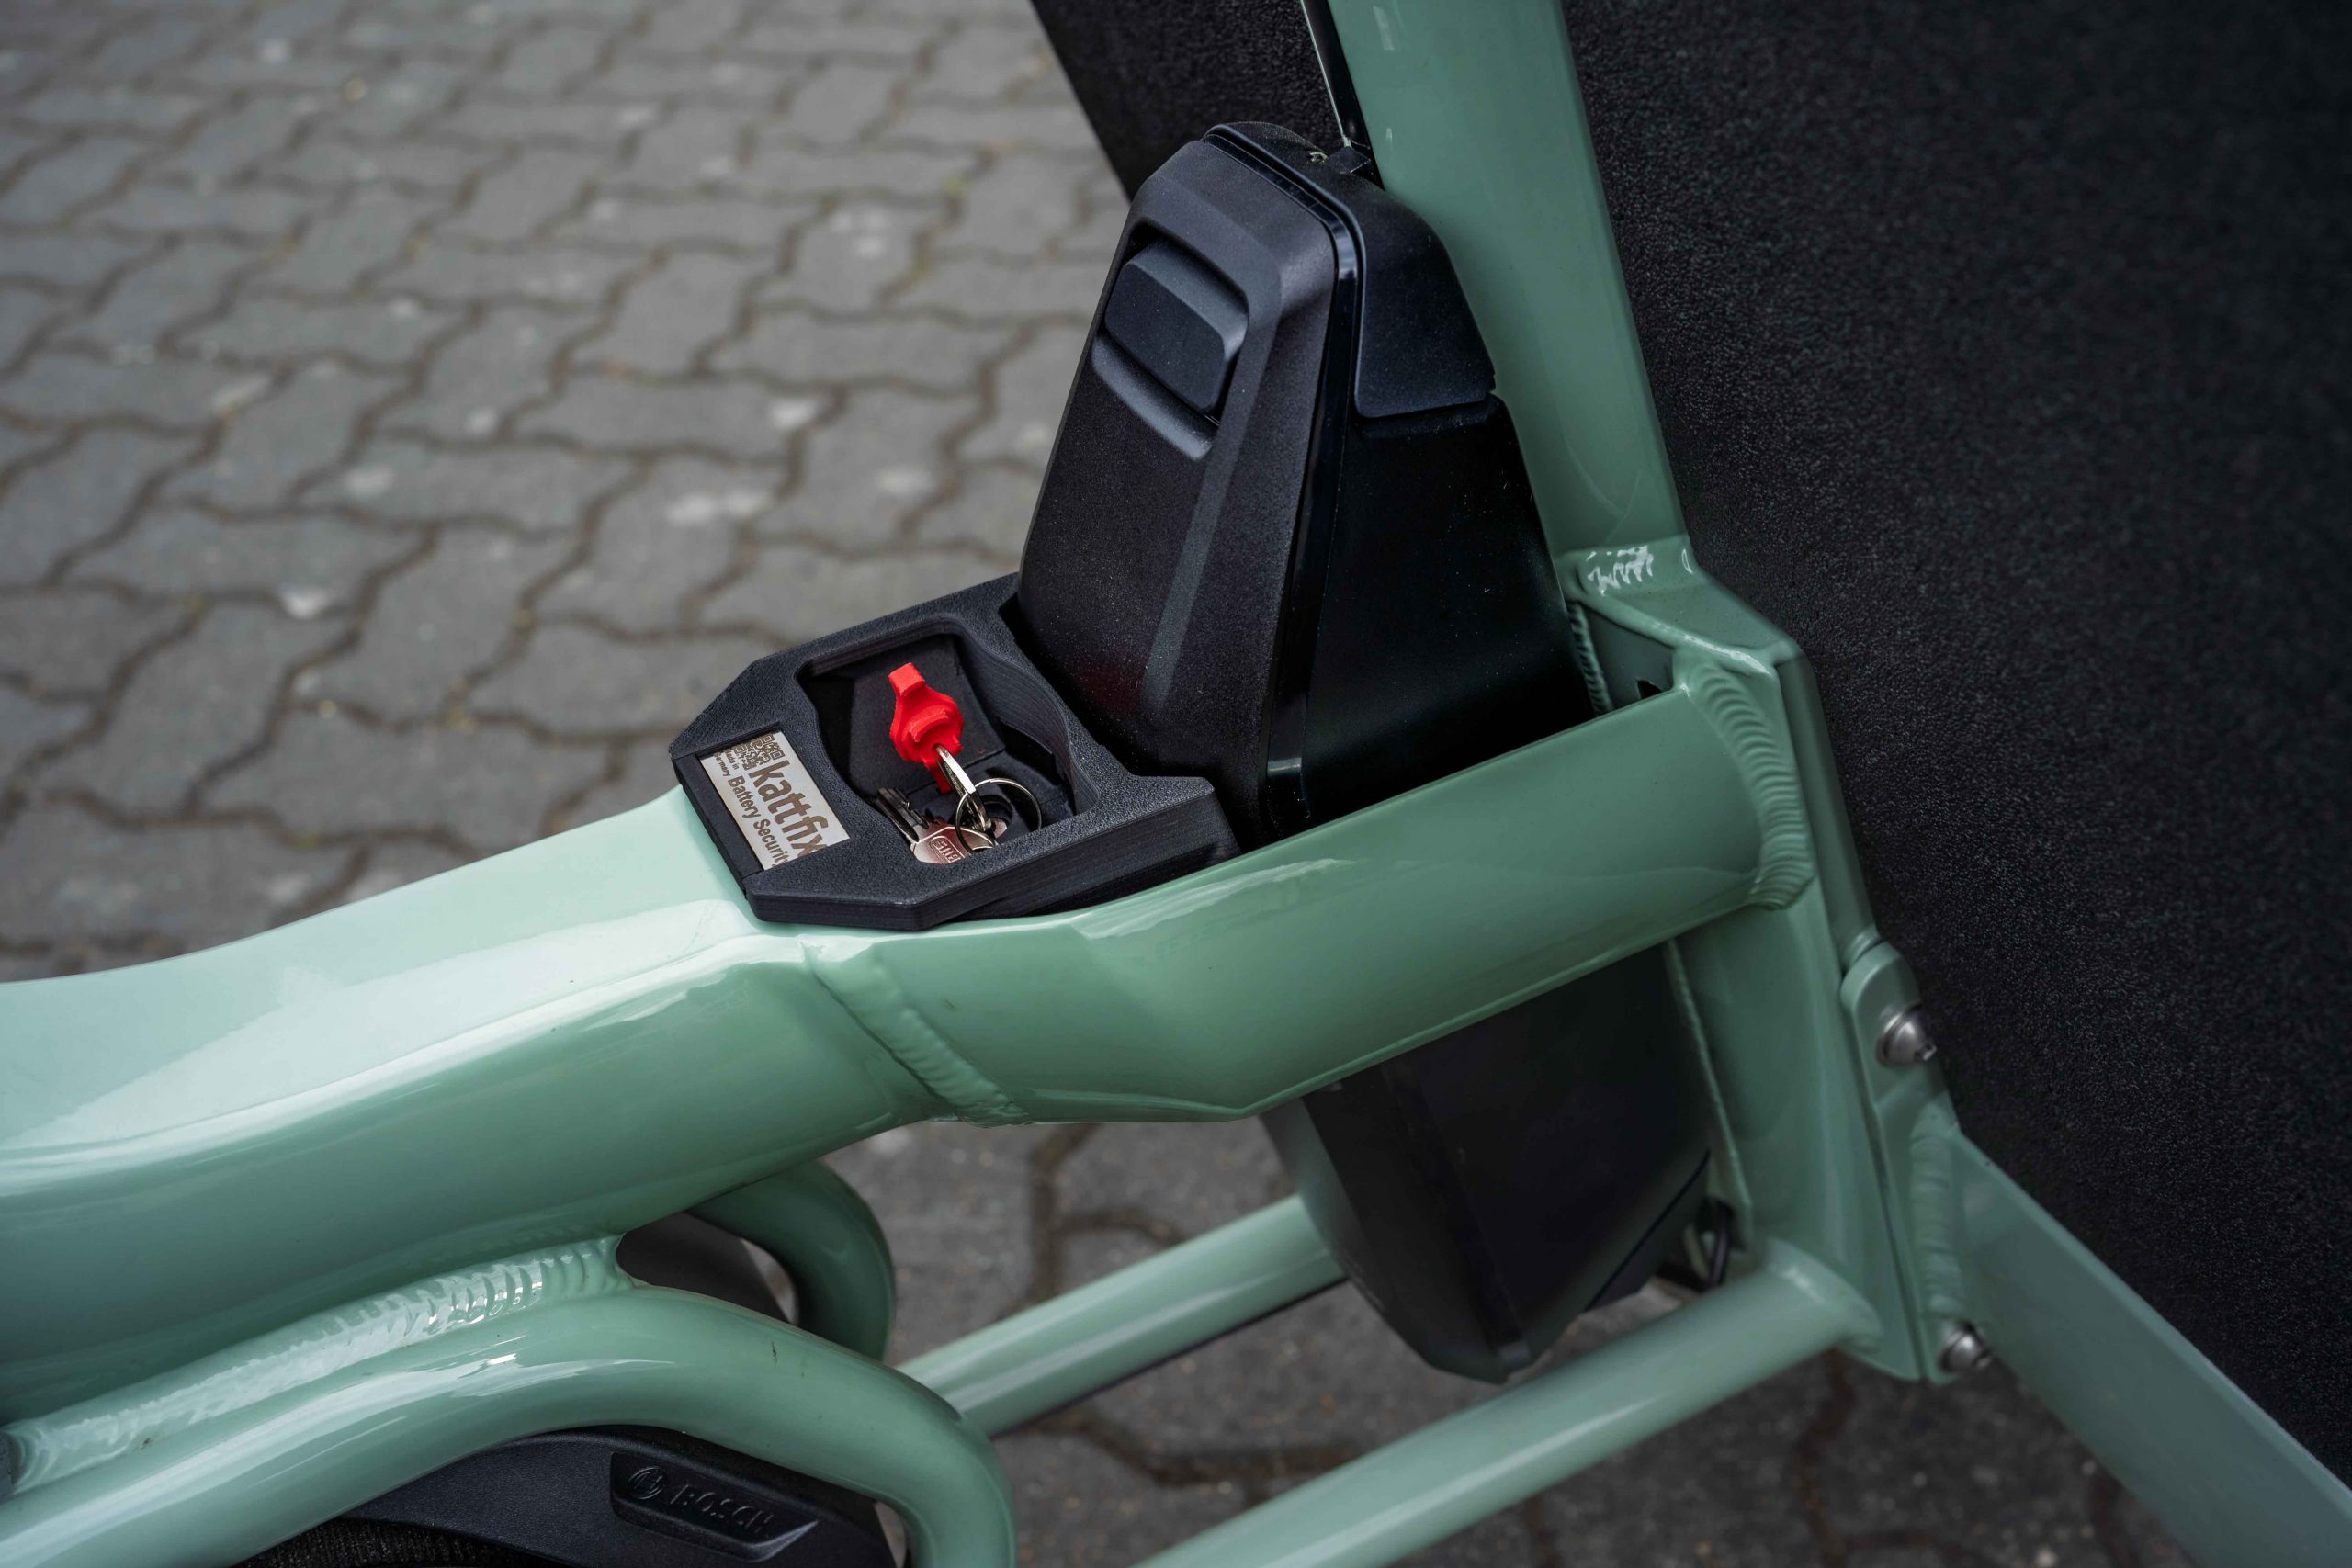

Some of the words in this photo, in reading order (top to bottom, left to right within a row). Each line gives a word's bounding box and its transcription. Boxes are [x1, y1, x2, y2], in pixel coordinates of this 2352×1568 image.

[731, 761, 740, 770] in
[727, 775, 761, 818] Battery
[748, 760, 829, 858] kattfix
[669, 1483, 775, 1535] BOSCH
